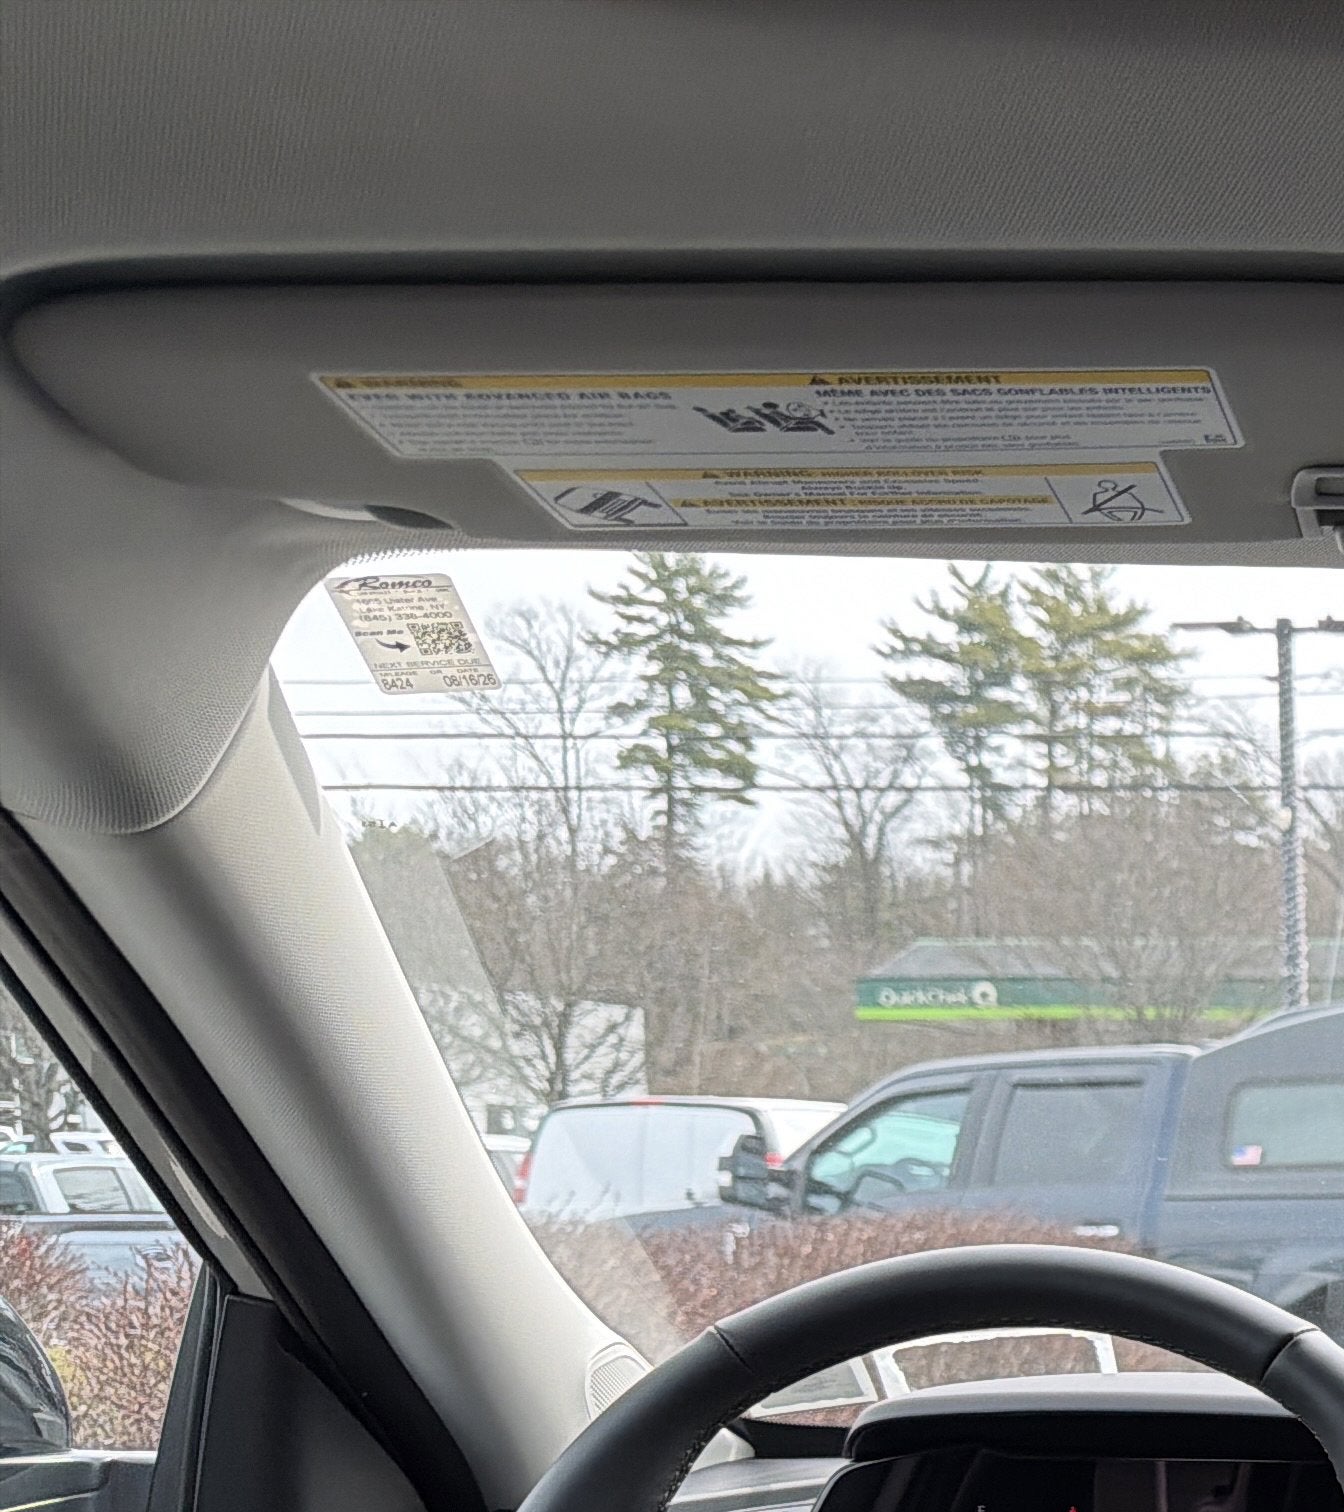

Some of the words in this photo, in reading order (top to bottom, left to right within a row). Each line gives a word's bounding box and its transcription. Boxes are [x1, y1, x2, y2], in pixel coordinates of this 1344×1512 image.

[914, 387, 947, 397] DES
[354, 630, 384, 638] Scan
[386, 628, 405, 636] Me
[406, 659, 455, 668] SERVICE
[457, 657, 481, 666] DUE
[455, 667, 480, 675] DATE
[382, 677, 414, 691] 8424
